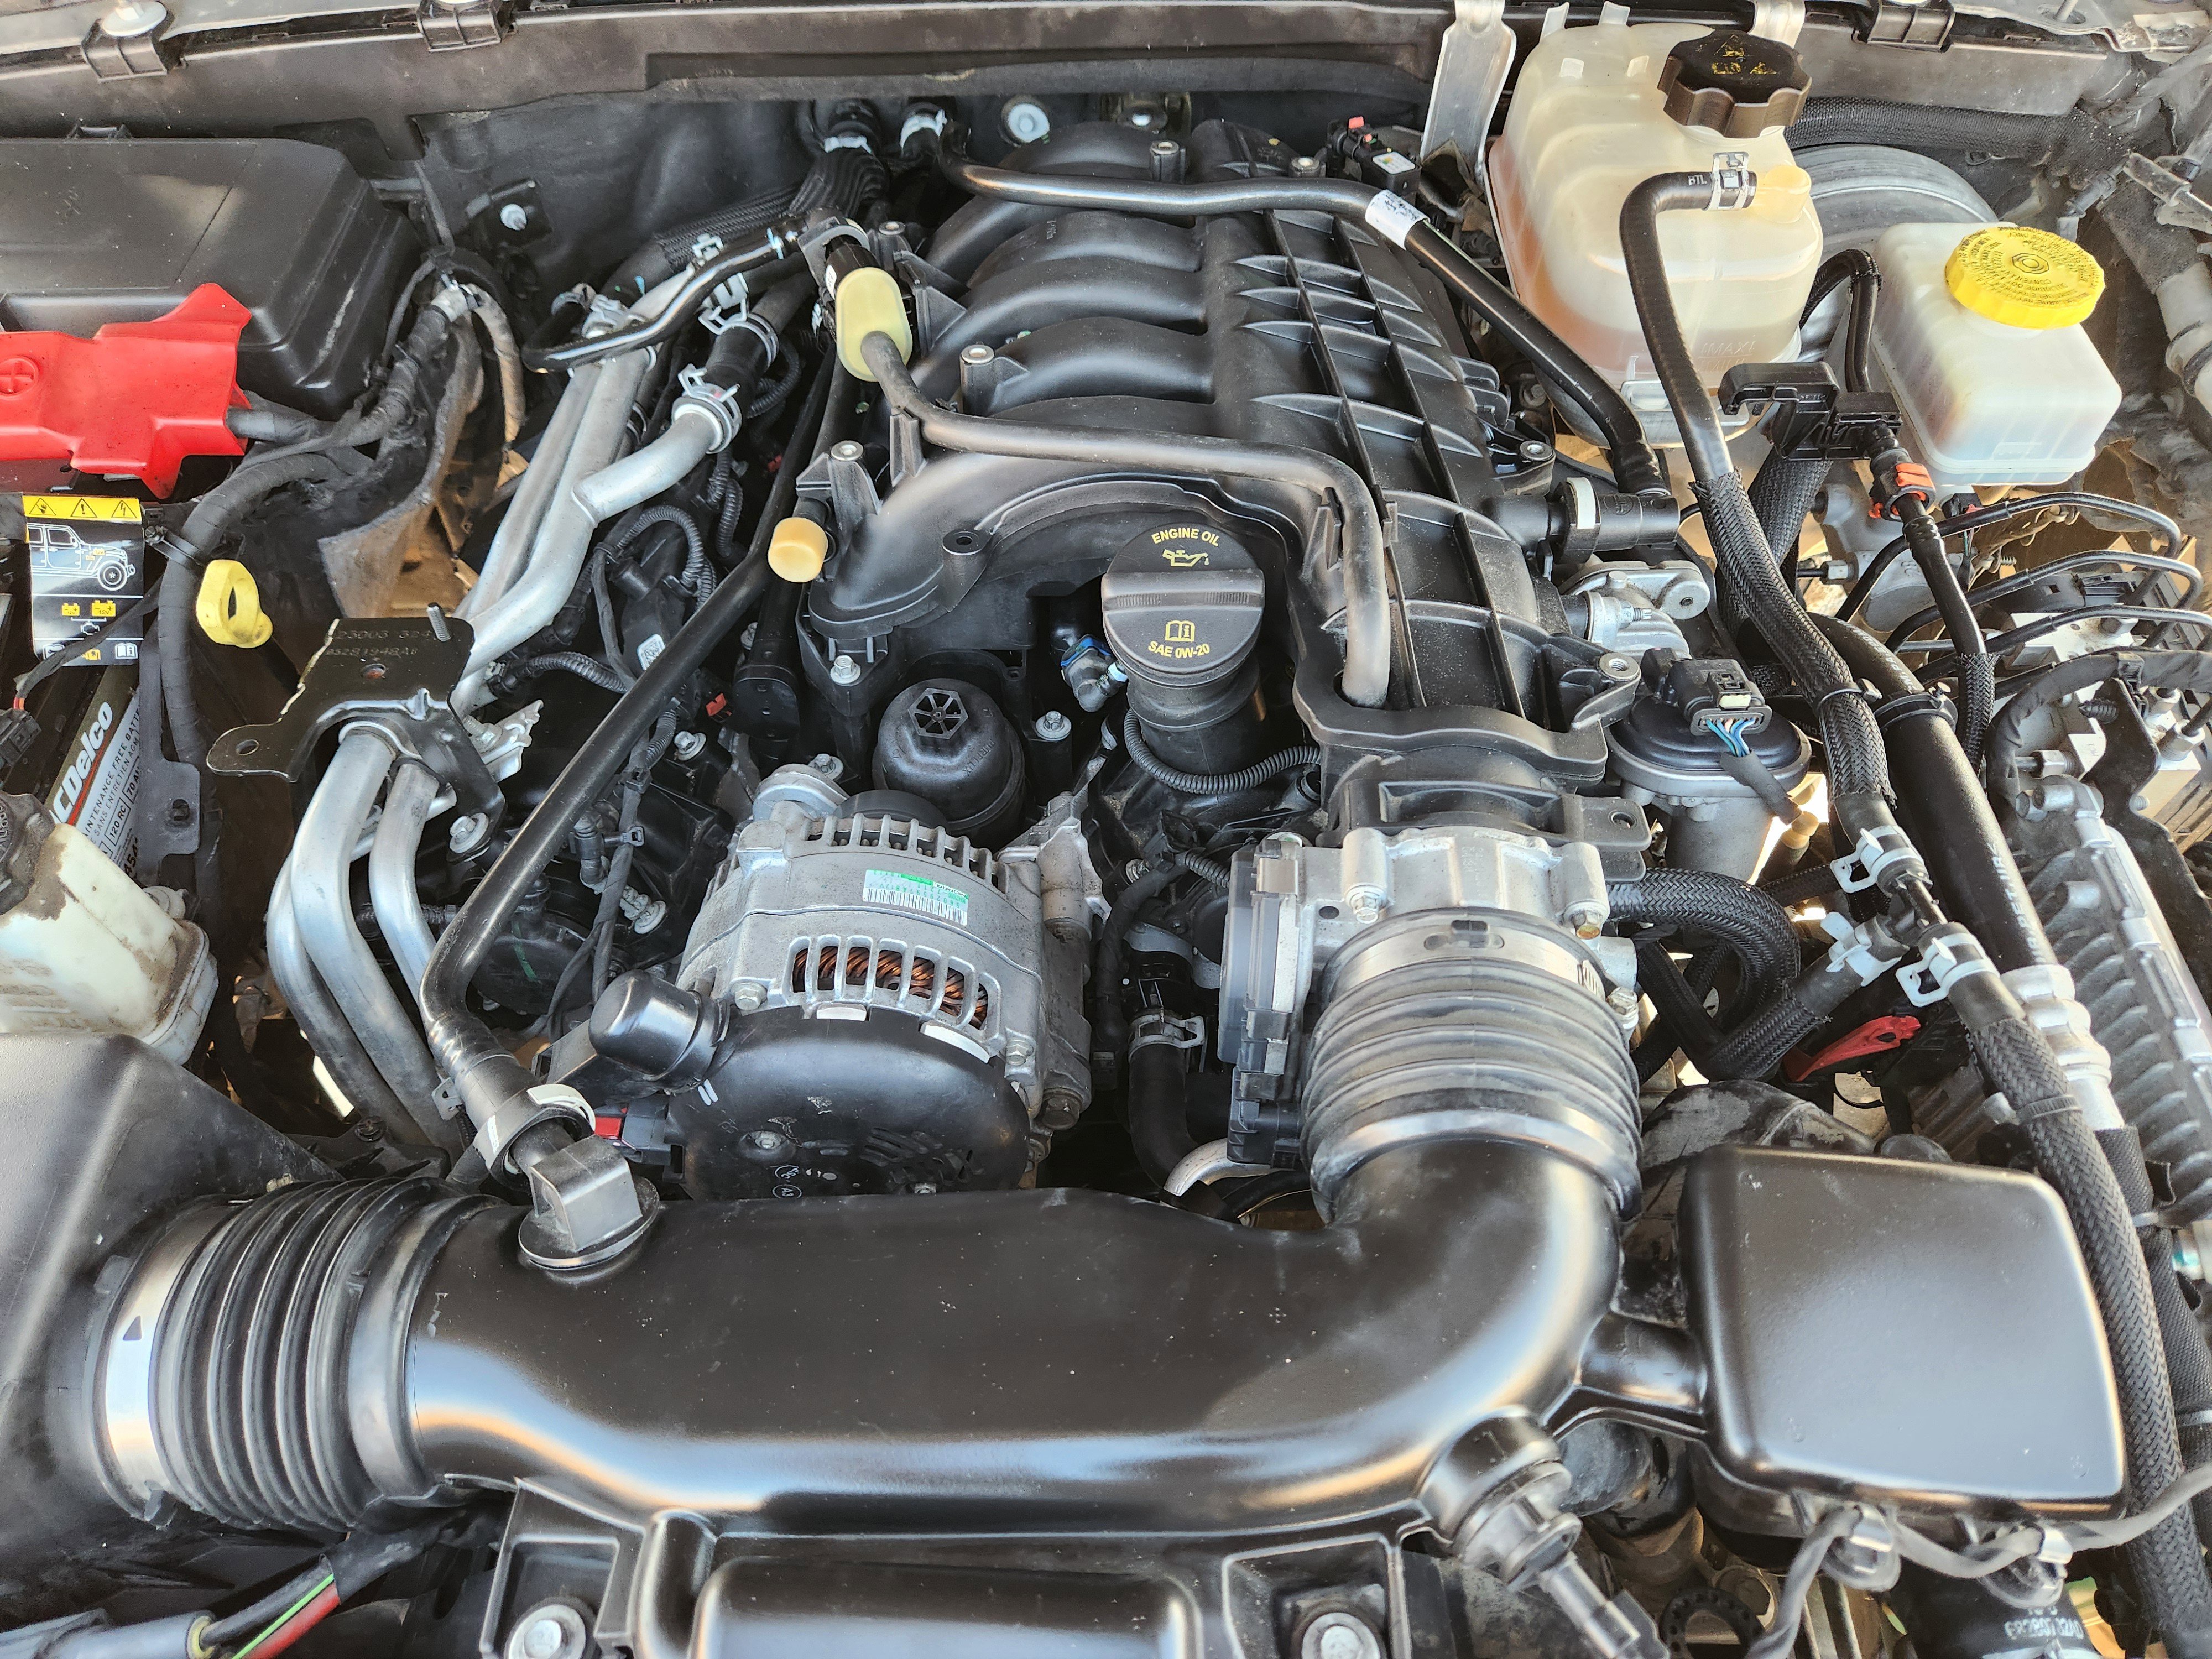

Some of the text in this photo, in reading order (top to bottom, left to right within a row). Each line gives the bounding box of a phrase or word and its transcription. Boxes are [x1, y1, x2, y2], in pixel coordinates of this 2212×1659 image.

[1151, 528, 1219, 547] ENGINE OIL
[1148, 641, 1210, 658] SAE 0W-20
[49, 702, 113, 824] CDelco
[84, 771, 114, 837] INTENANCE
[112, 743, 128, 770] FREE
[93, 810, 108, 836] SANS
[106, 758, 131, 810] ENTRETIEN
[127, 782, 136, 796] 70
[109, 821, 120, 839] 120
[118, 805, 127, 821] RC
